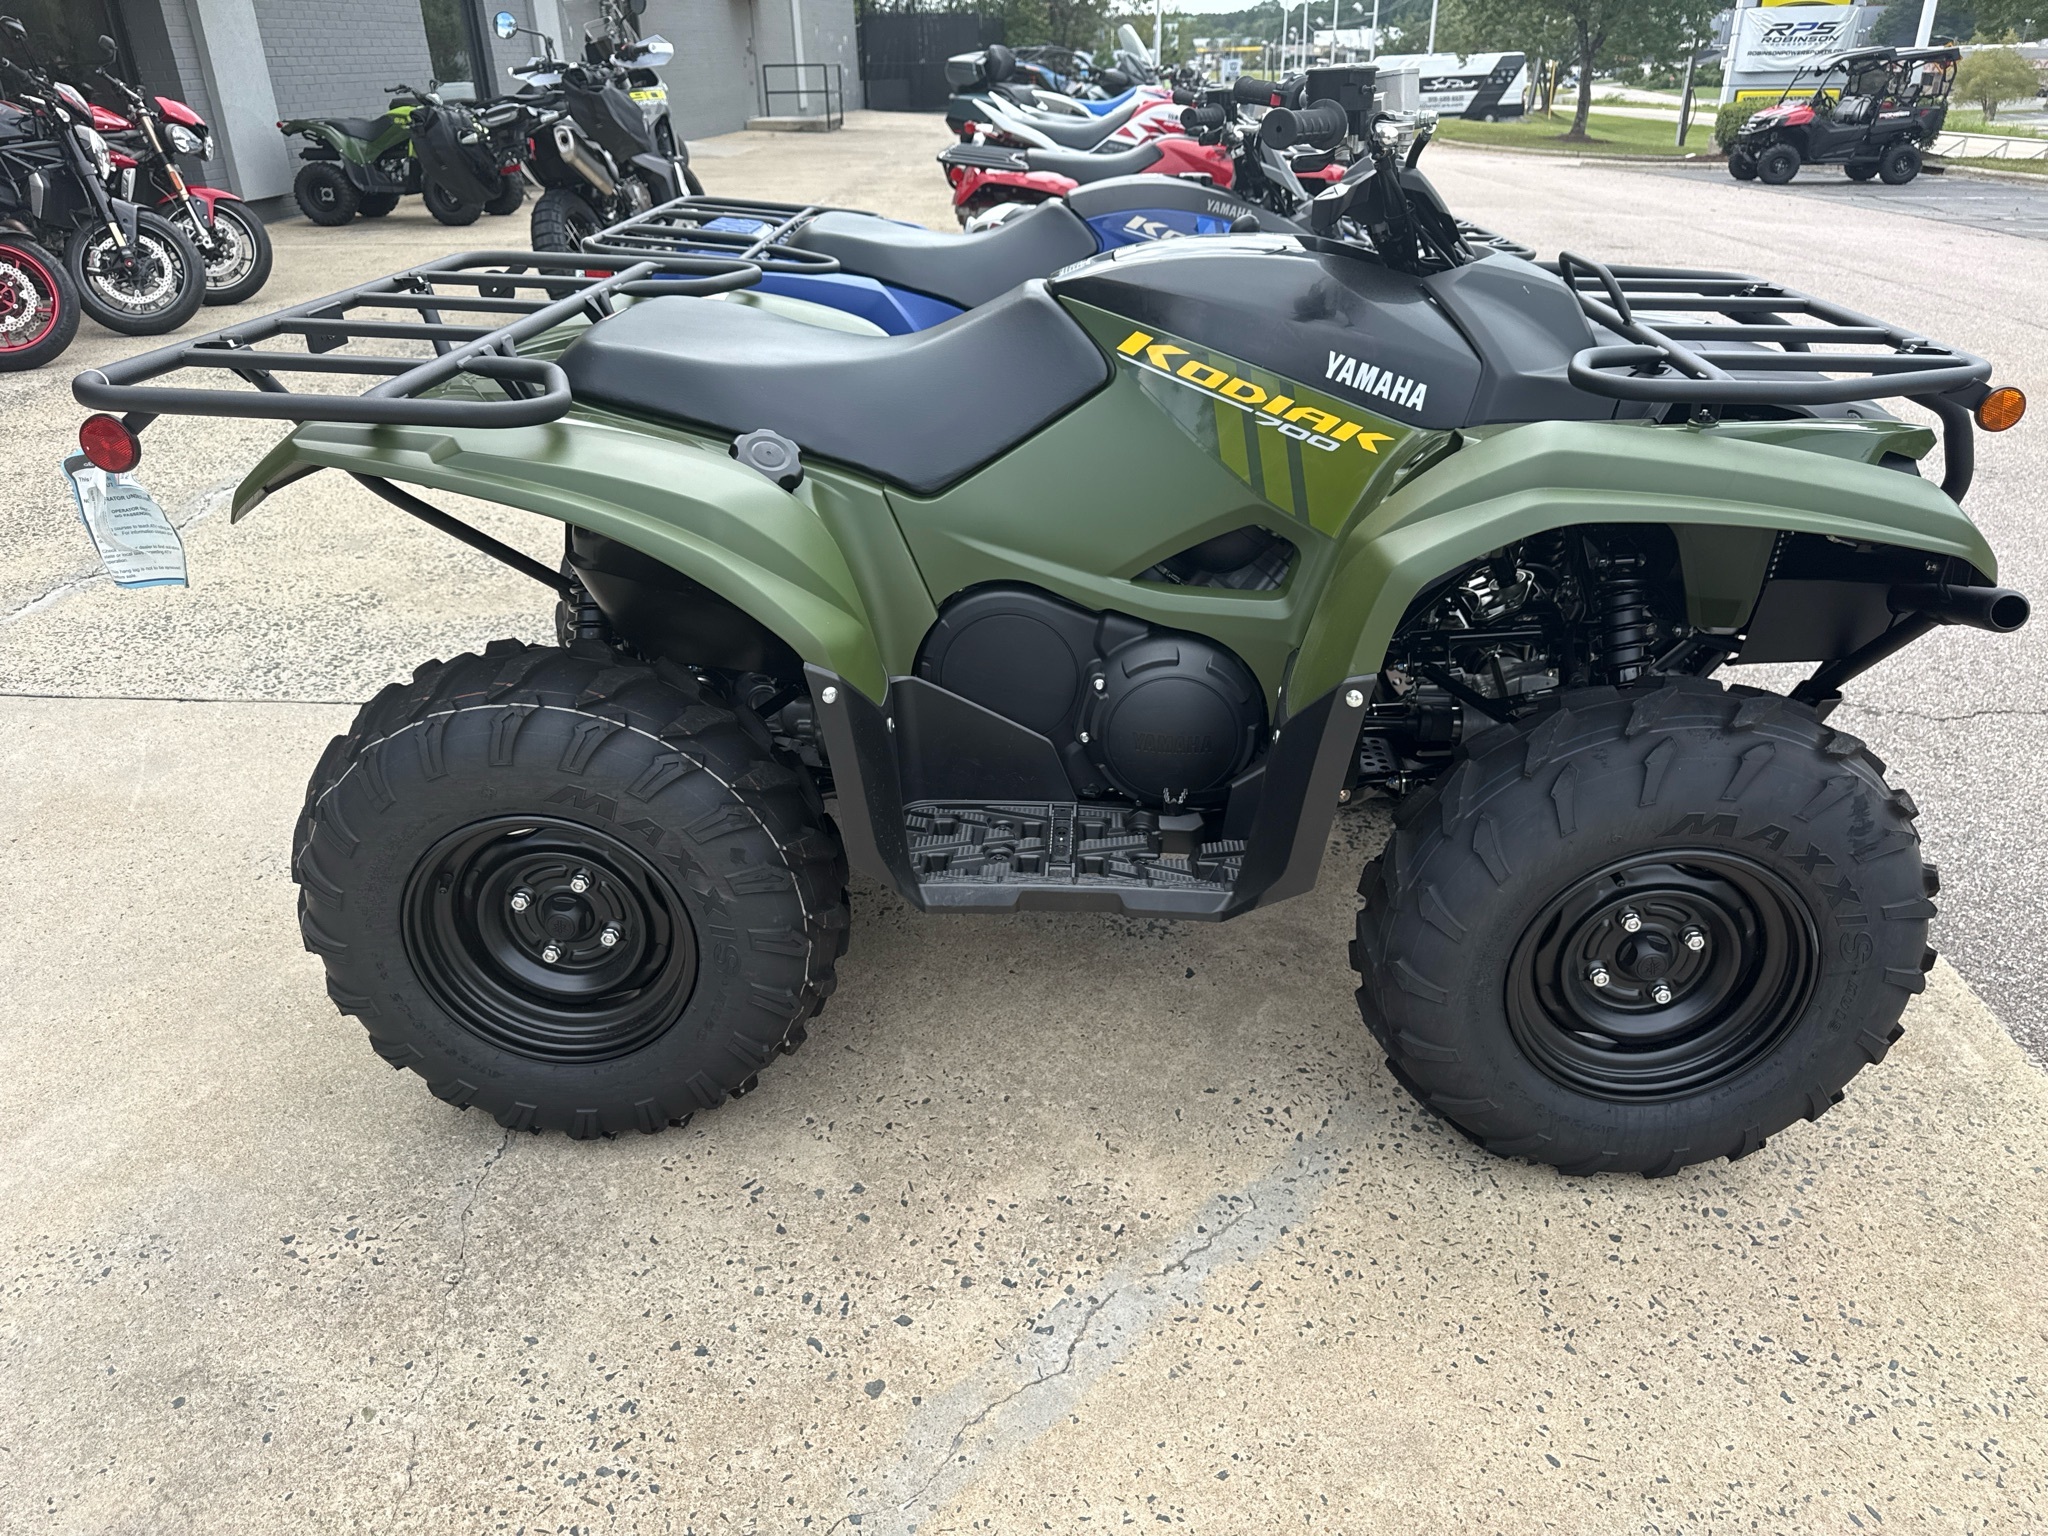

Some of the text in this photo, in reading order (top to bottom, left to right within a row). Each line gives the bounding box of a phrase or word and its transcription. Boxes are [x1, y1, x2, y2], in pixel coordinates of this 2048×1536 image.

[1761, 35, 1840, 43] ROBINSON
[1763, 21, 1839, 36] RPS
[1116, 330, 1395, 454] KODIAK
[1324, 350, 1428, 412] YAMAHA
[1254, 411, 1341, 452] 700
[1133, 731, 1214, 755] YAMAHA
[544, 783, 742, 978] MAXXIS
[1655, 811, 1874, 964] MAXXIS
